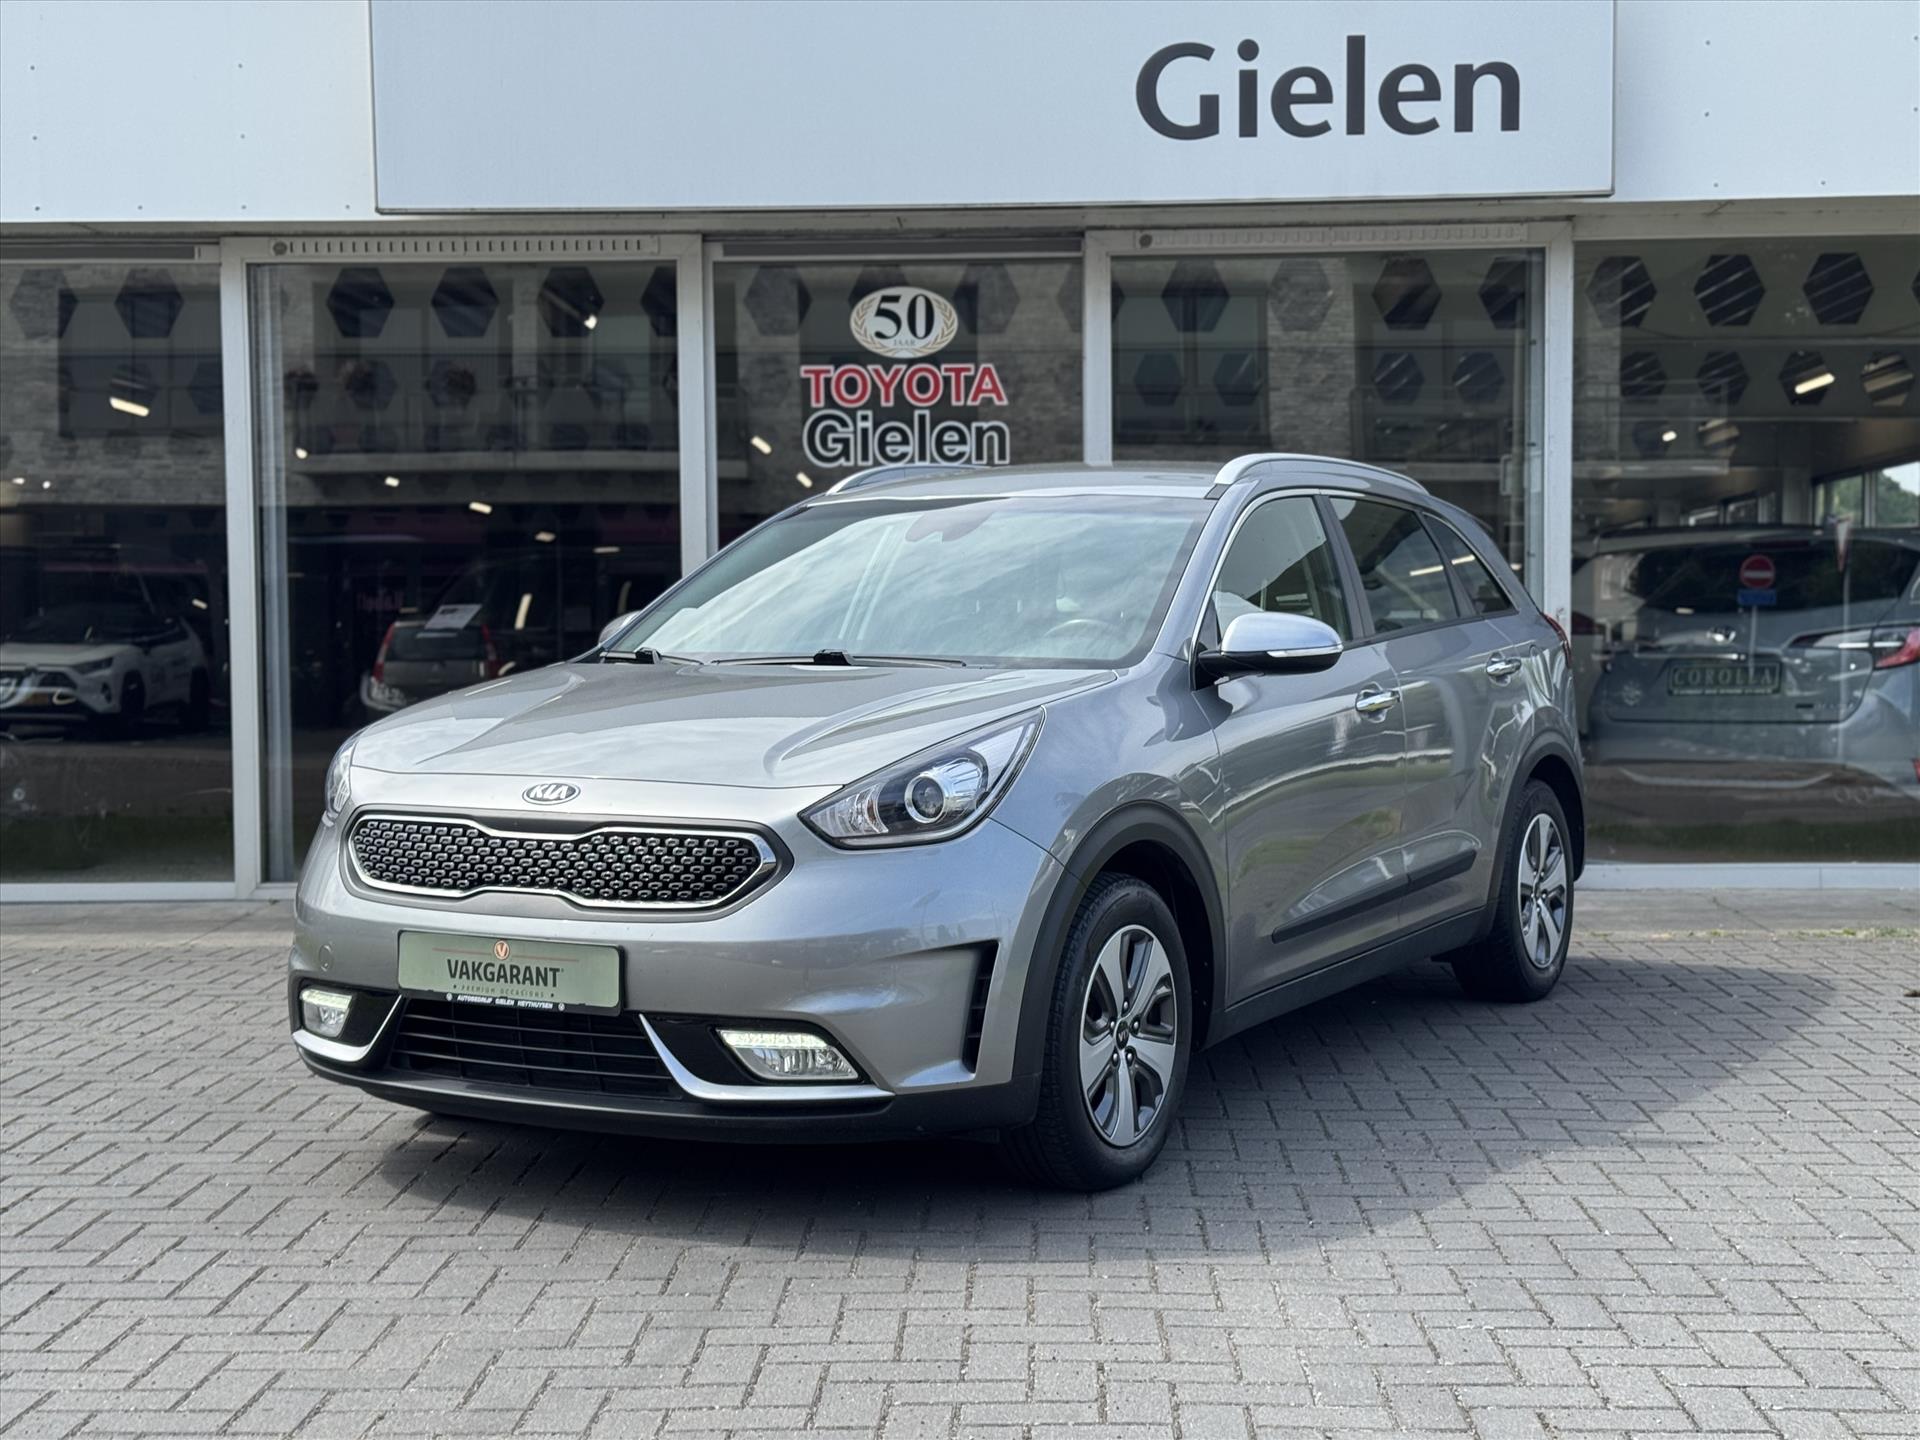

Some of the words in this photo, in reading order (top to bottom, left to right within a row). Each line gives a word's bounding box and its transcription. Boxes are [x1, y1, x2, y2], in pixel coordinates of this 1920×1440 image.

[1136, 35, 1520, 140] Gielen
[874, 293, 935, 340] 50
[801, 363, 1009, 407] TOYOTA
[802, 409, 1010, 468] Gielen
[1674, 668, 1773, 686] COROLLA
[529, 784, 569, 800] KIA
[447, 959, 560, 988] VAKGARANT
[460, 984, 496, 995] PREMIUM
[500, 987, 545, 998] OCCASIONS
